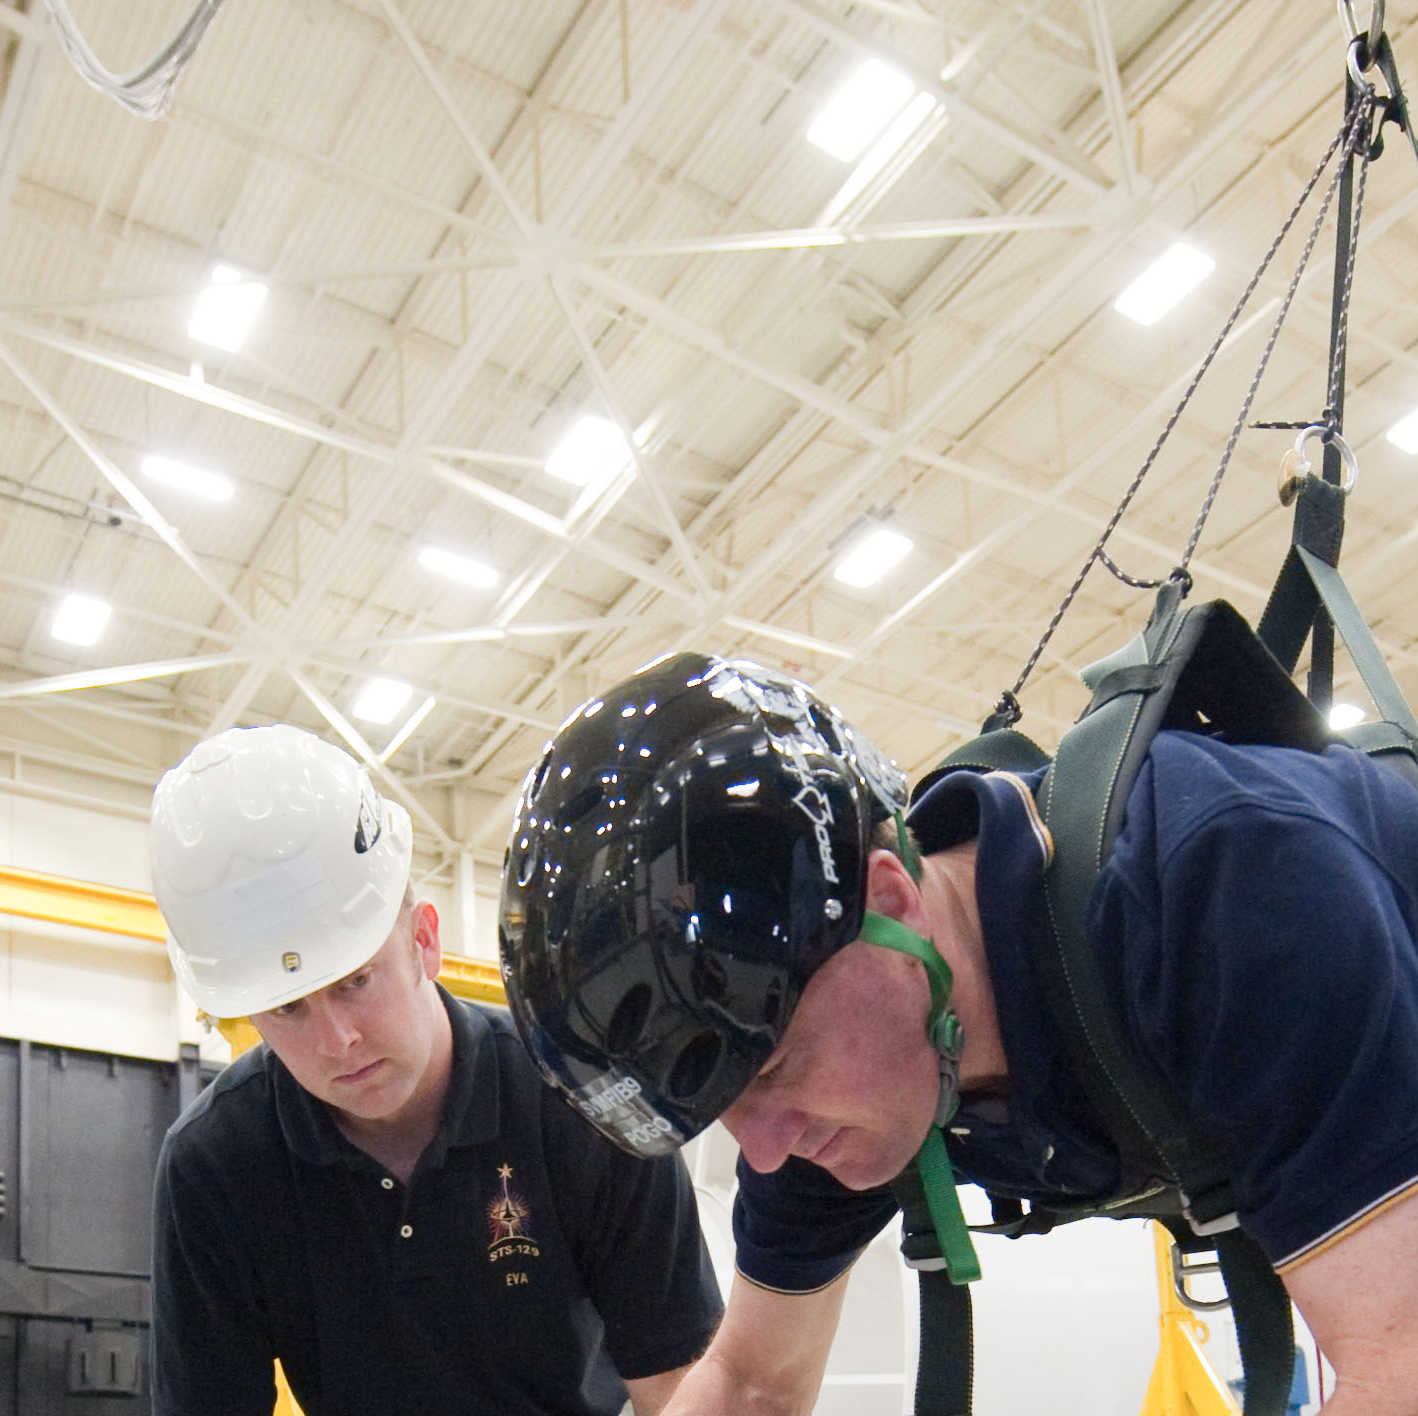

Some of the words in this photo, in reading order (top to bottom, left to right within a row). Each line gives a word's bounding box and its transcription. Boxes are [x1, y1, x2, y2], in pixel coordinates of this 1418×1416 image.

[814, 823, 840, 884] PRO
[623, 1115, 673, 1147] POGO
[489, 1243, 541, 1262] STS-129
[505, 1272, 529, 1287] EVA
